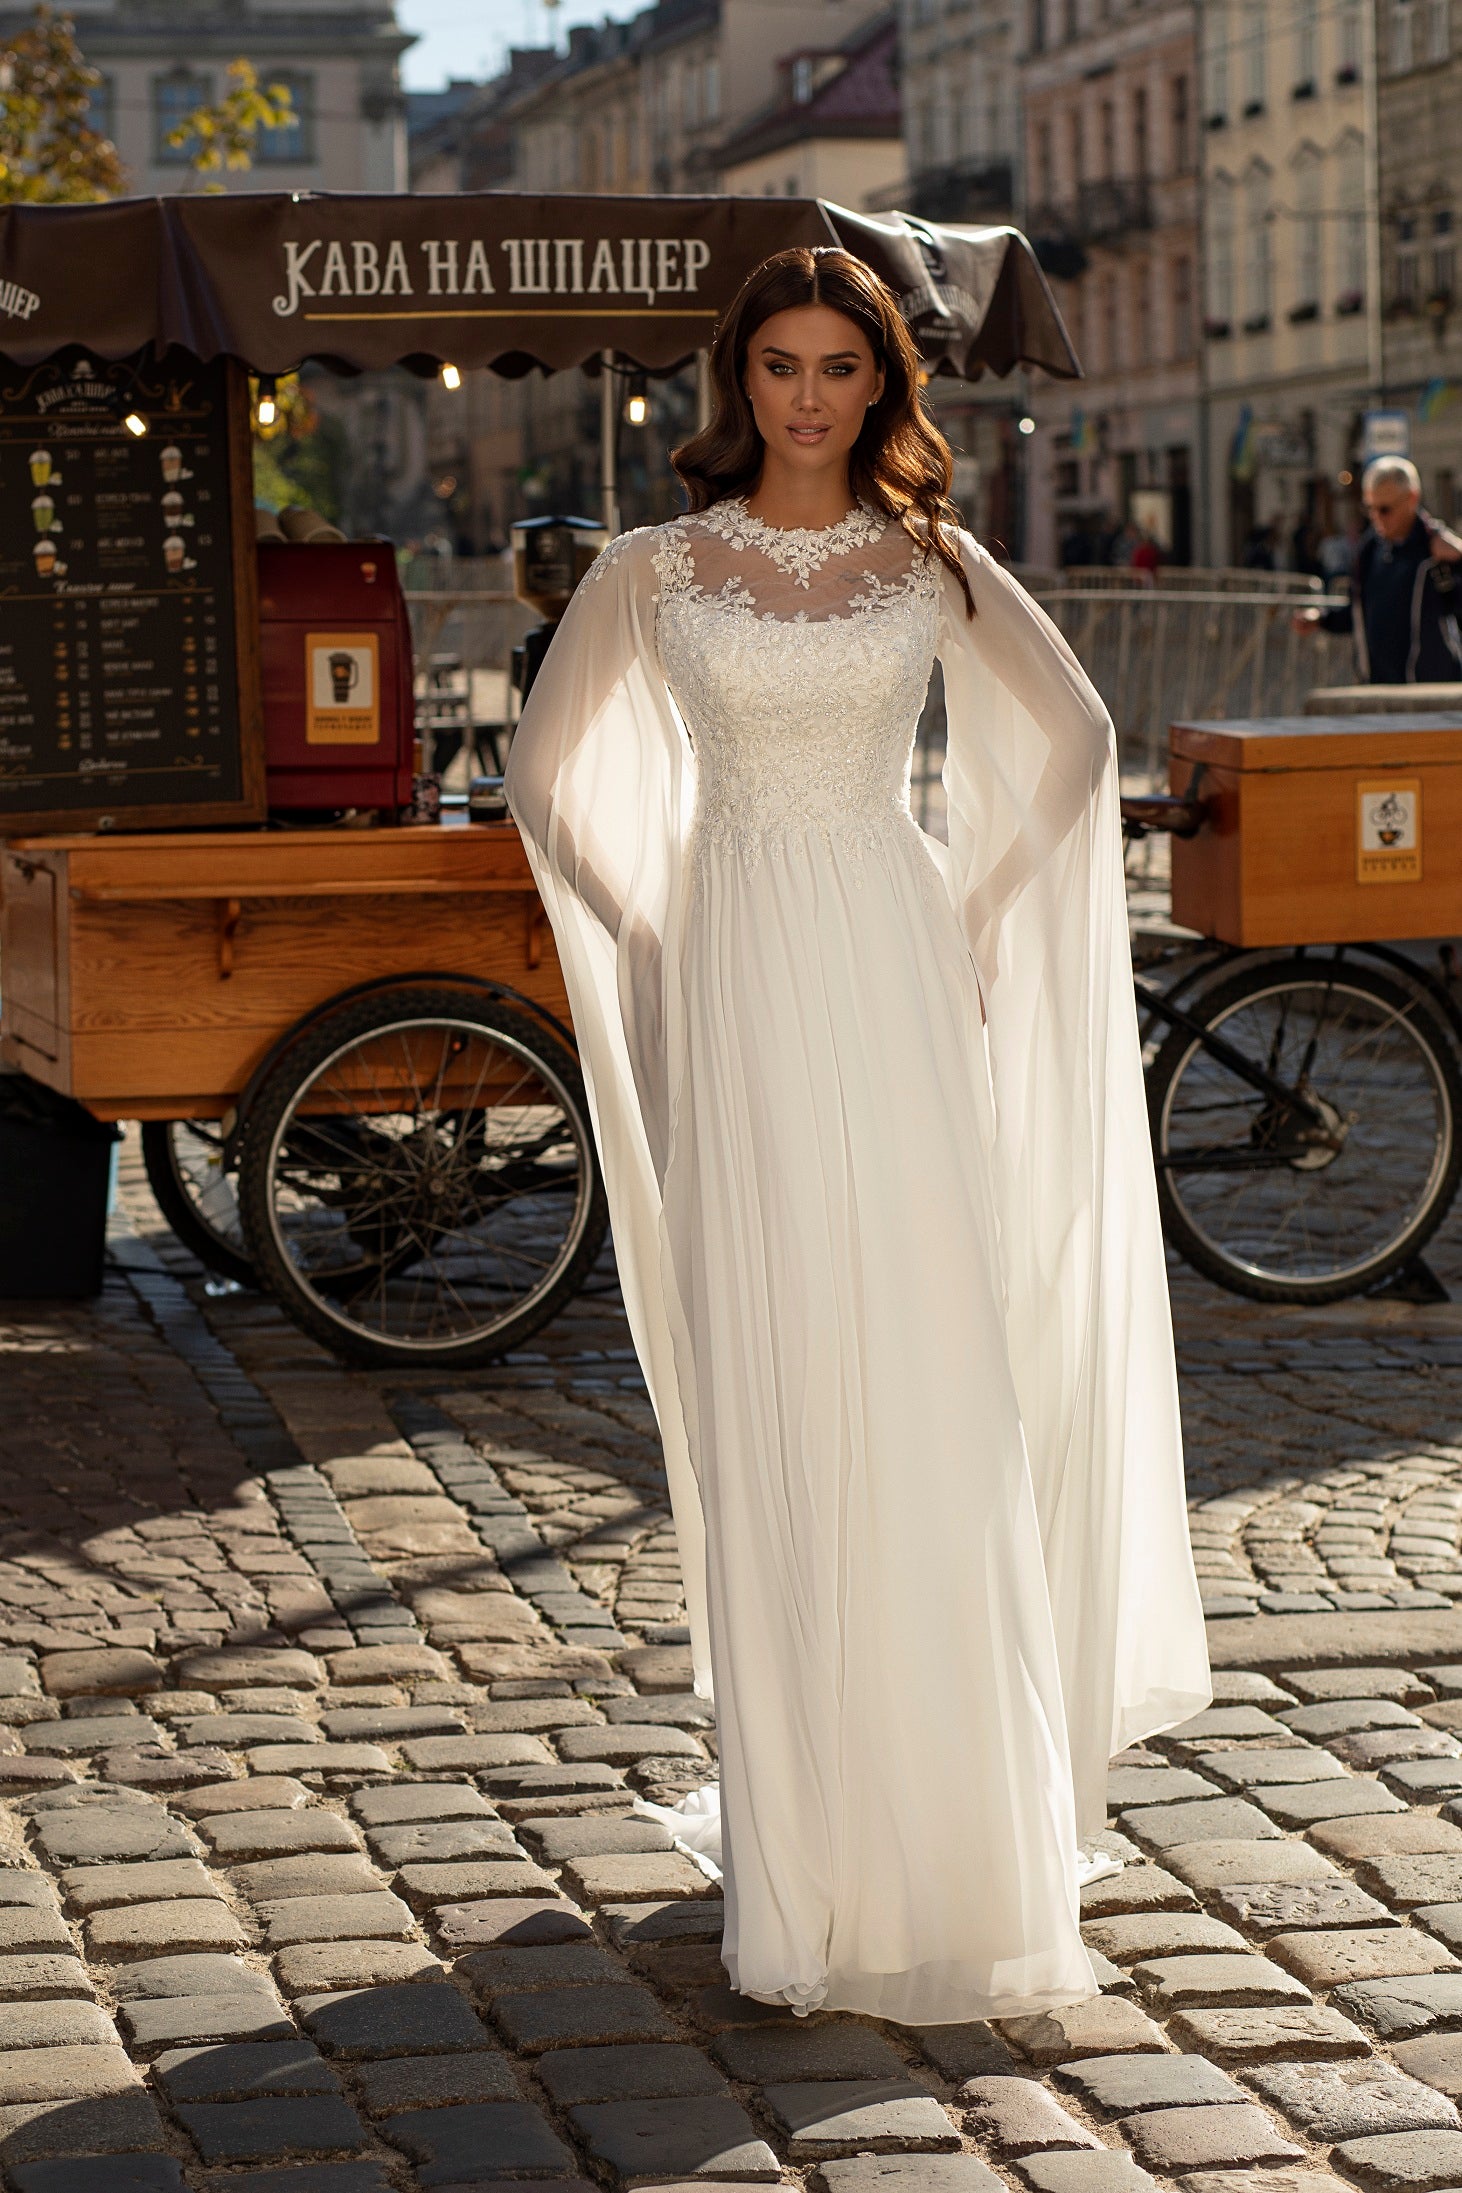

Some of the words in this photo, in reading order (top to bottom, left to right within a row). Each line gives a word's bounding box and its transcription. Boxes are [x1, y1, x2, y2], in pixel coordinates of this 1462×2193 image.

[272, 240, 414, 317] КАВА
[421, 240, 495, 295] НА
[501, 238, 711, 306] ШПАЦЕР
